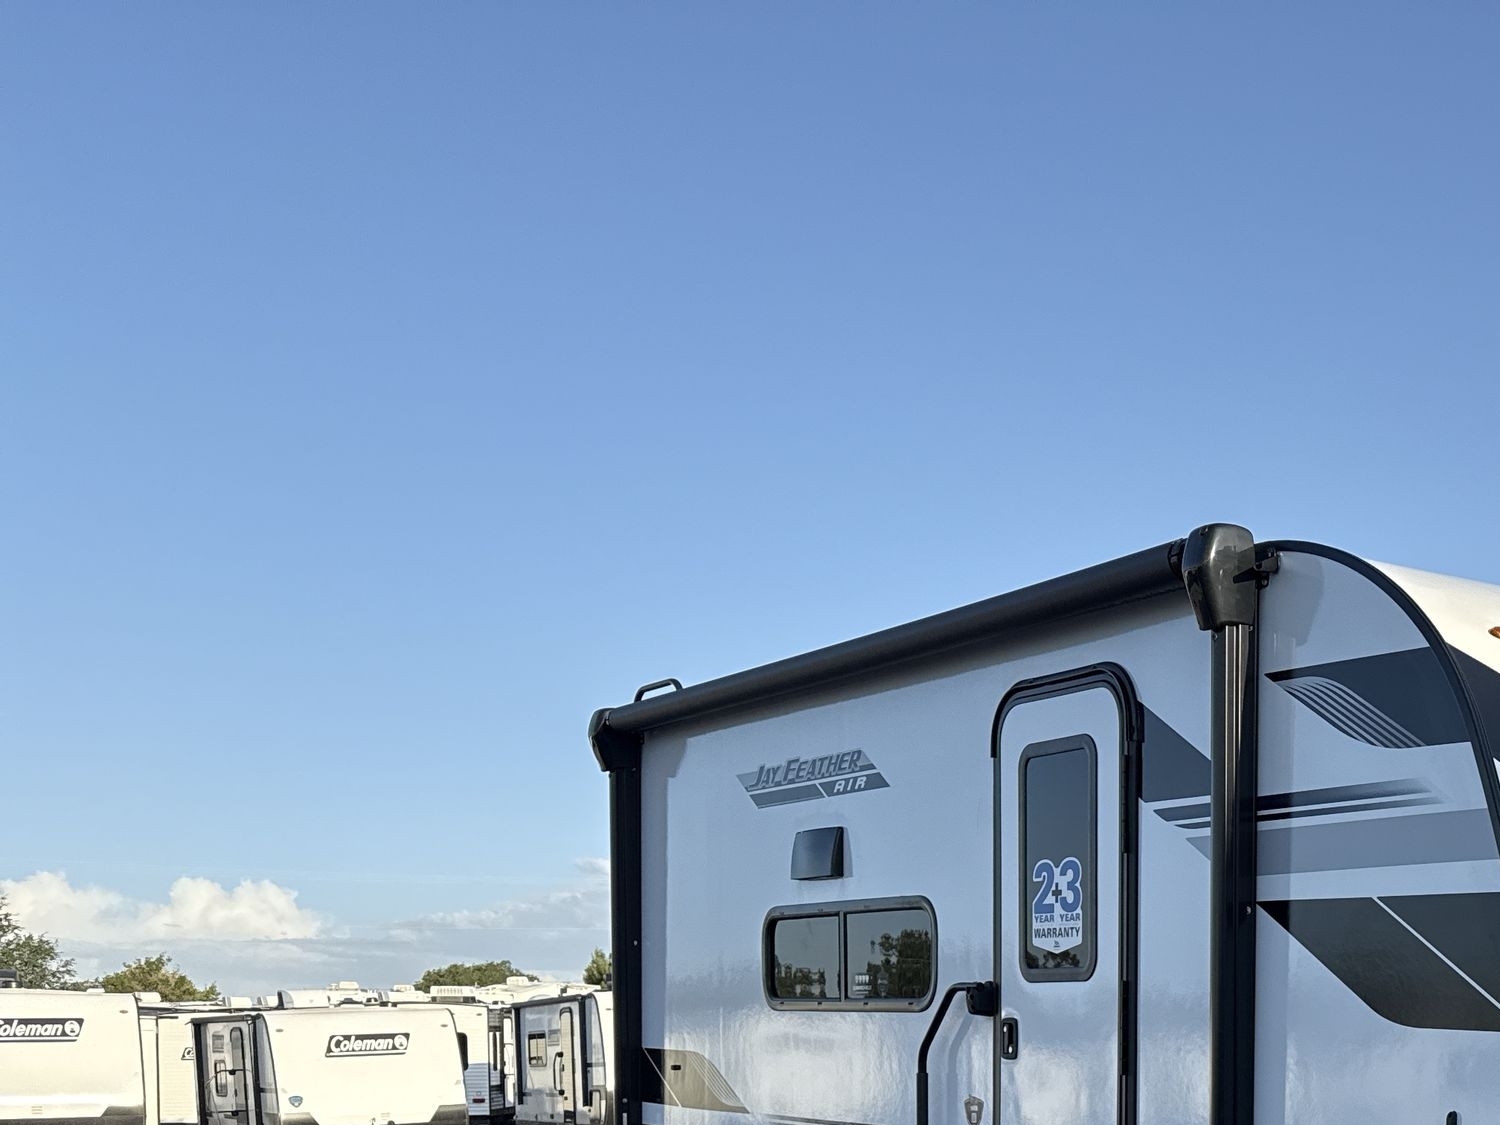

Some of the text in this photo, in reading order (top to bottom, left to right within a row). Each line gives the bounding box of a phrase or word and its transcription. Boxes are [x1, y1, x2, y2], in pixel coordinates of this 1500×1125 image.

[749, 750, 862, 790] JAY FEATHER
[833, 776, 867, 793] AIR
[1034, 913, 1081, 923] YEAR YEAR
[1034, 926, 1081, 939] WARRANTY
[0, 1019, 63, 1037] oleman
[330, 1035, 394, 1053] Coleman
